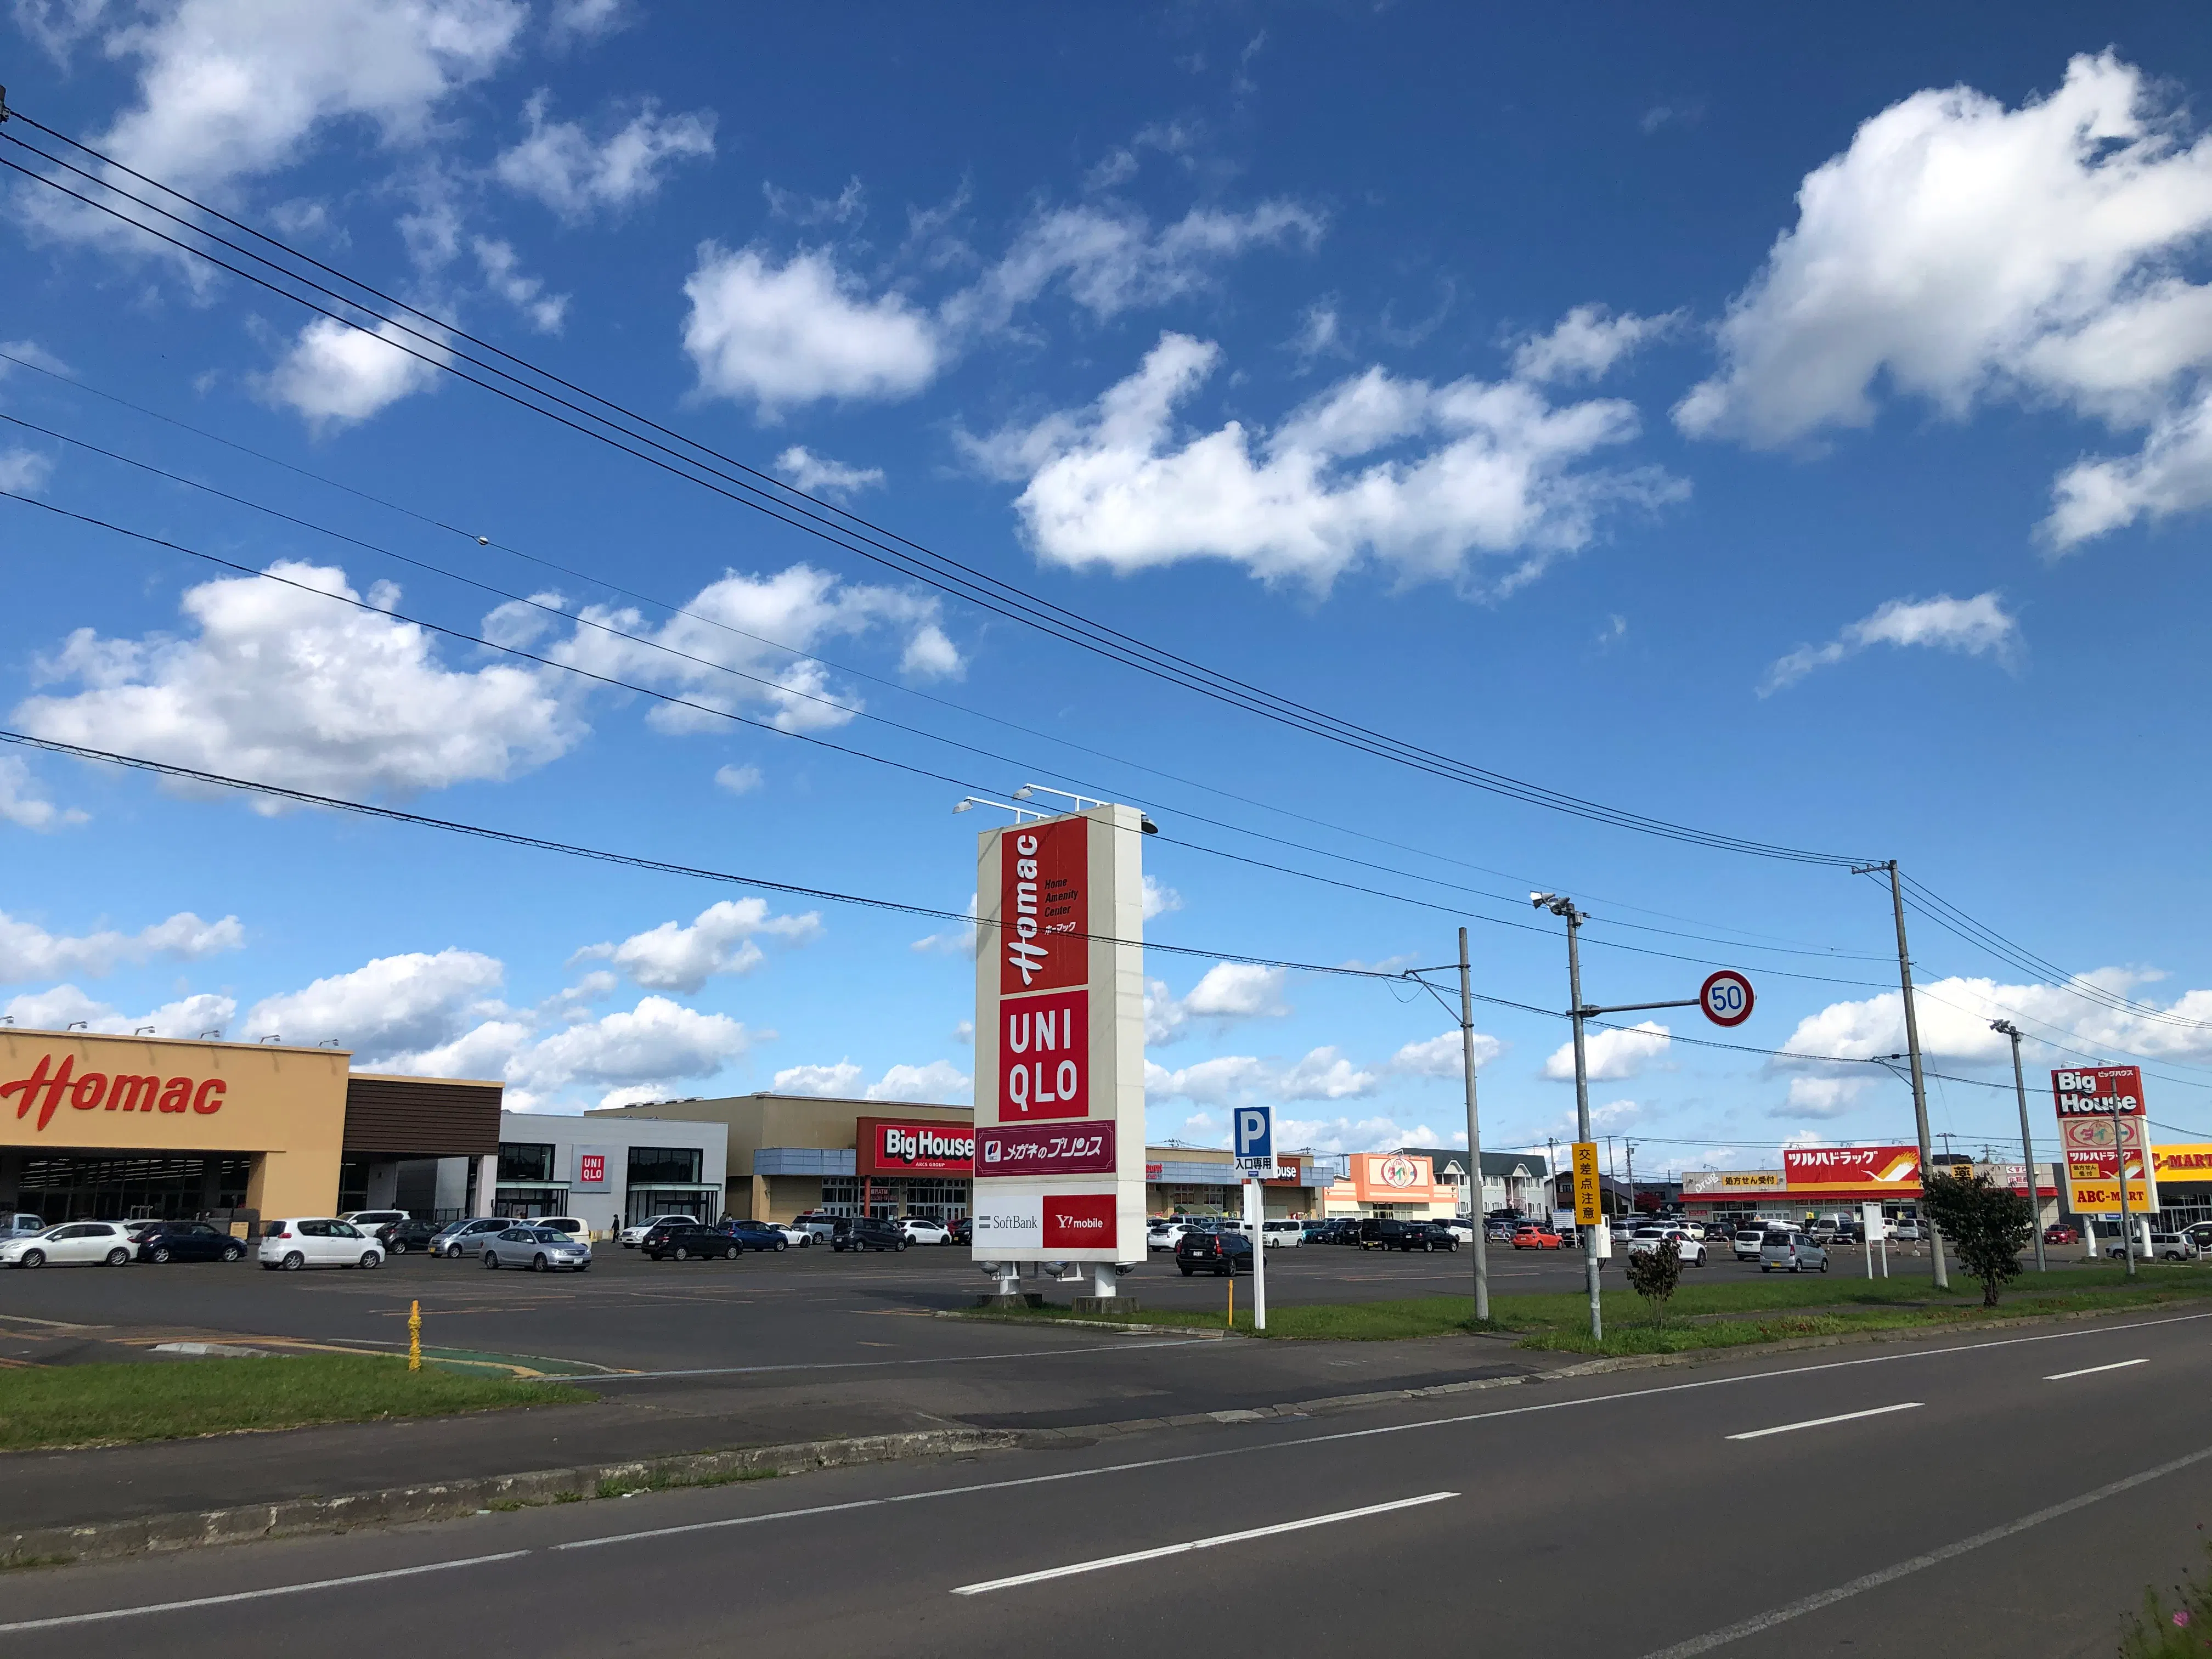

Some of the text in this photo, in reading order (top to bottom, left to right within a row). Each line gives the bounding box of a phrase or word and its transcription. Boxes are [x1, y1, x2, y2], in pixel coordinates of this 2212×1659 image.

[1045, 878, 1068, 890] Home
[1045, 889, 1078, 903] Amenity
[1008, 835, 1048, 985] Homac
[1045, 905, 1071, 917] Center
[1045, 922, 1076, 935] ホーマック
[1712, 986, 1741, 1011] 50
[1010, 1008, 1070, 1053] UNI
[1009, 1060, 1077, 1111] QLO
[2058, 1071, 2096, 1093] Big
[0, 1054, 227, 1131] Homac
[2061, 1094, 2137, 1112] House
[1240, 1110, 1266, 1154] P
[887, 1129, 974, 1160] Big House
[1003, 1136, 1102, 1160] メガネのプリンス
[584, 1158, 601, 1169] UNI
[1235, 1158, 1271, 1170] 入口専用
[1788, 1150, 1880, 1166] ツルハドラッグ
[584, 1169, 602, 1180] QLO
[1579, 1148, 1594, 1219] 交差点注意
[1695, 1172, 1719, 1194] Drug
[1725, 1176, 1775, 1185] 処方せん受付
[2077, 1190, 2144, 1203] ABC-MRT
[994, 1215, 1037, 1229] SoftBank
